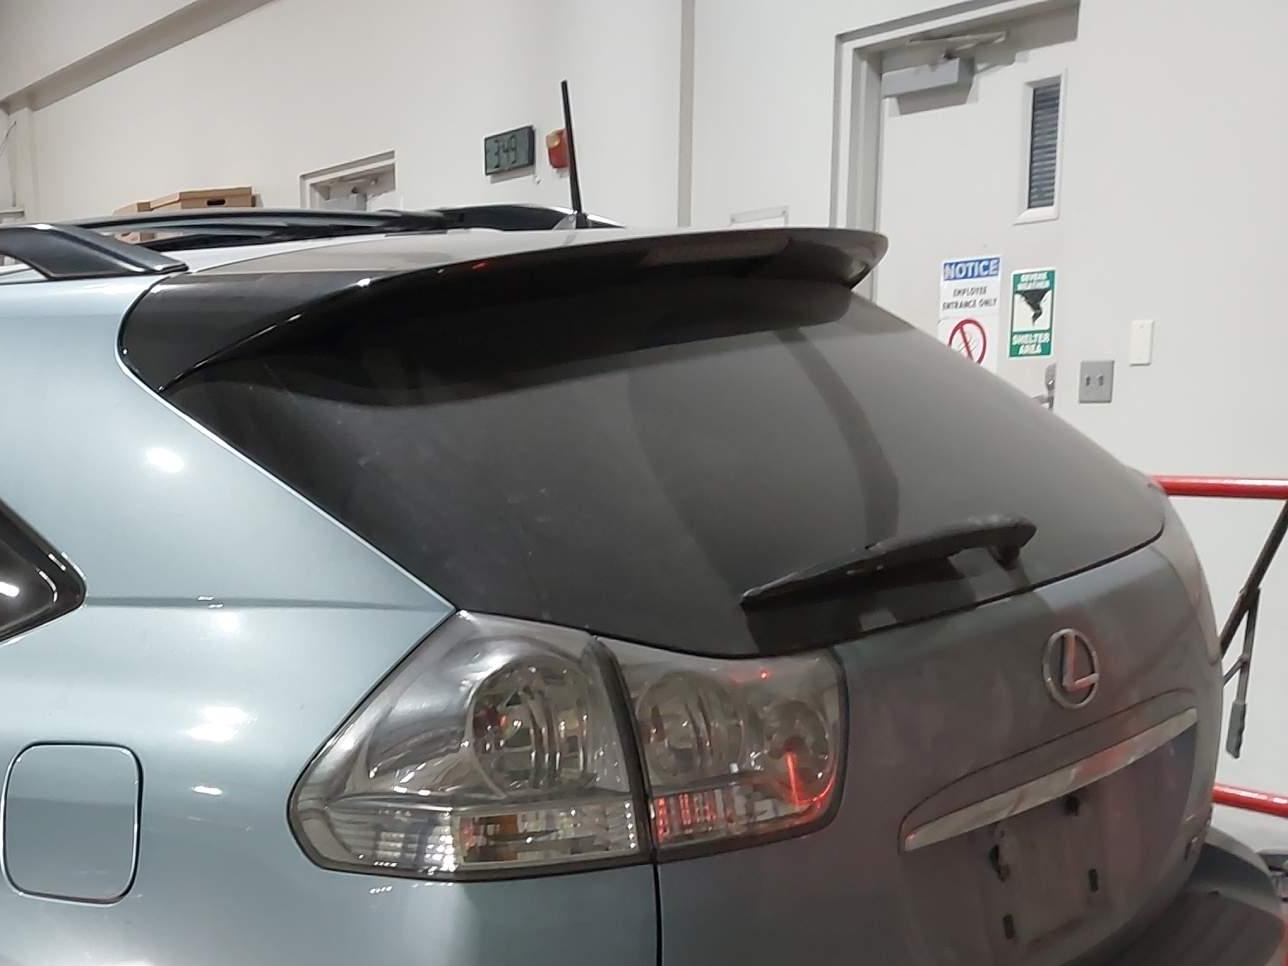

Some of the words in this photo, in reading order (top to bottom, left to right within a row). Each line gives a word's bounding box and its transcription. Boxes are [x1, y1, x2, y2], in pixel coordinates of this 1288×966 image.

[944, 259, 999, 279] NOTICE
[953, 286, 987, 297] EMPLOYEE
[942, 300, 977, 310] ENTRANCE
[978, 298, 997, 307] ONLY
[1012, 333, 1050, 345] SHELTER
[1018, 343, 1042, 355] AREA
